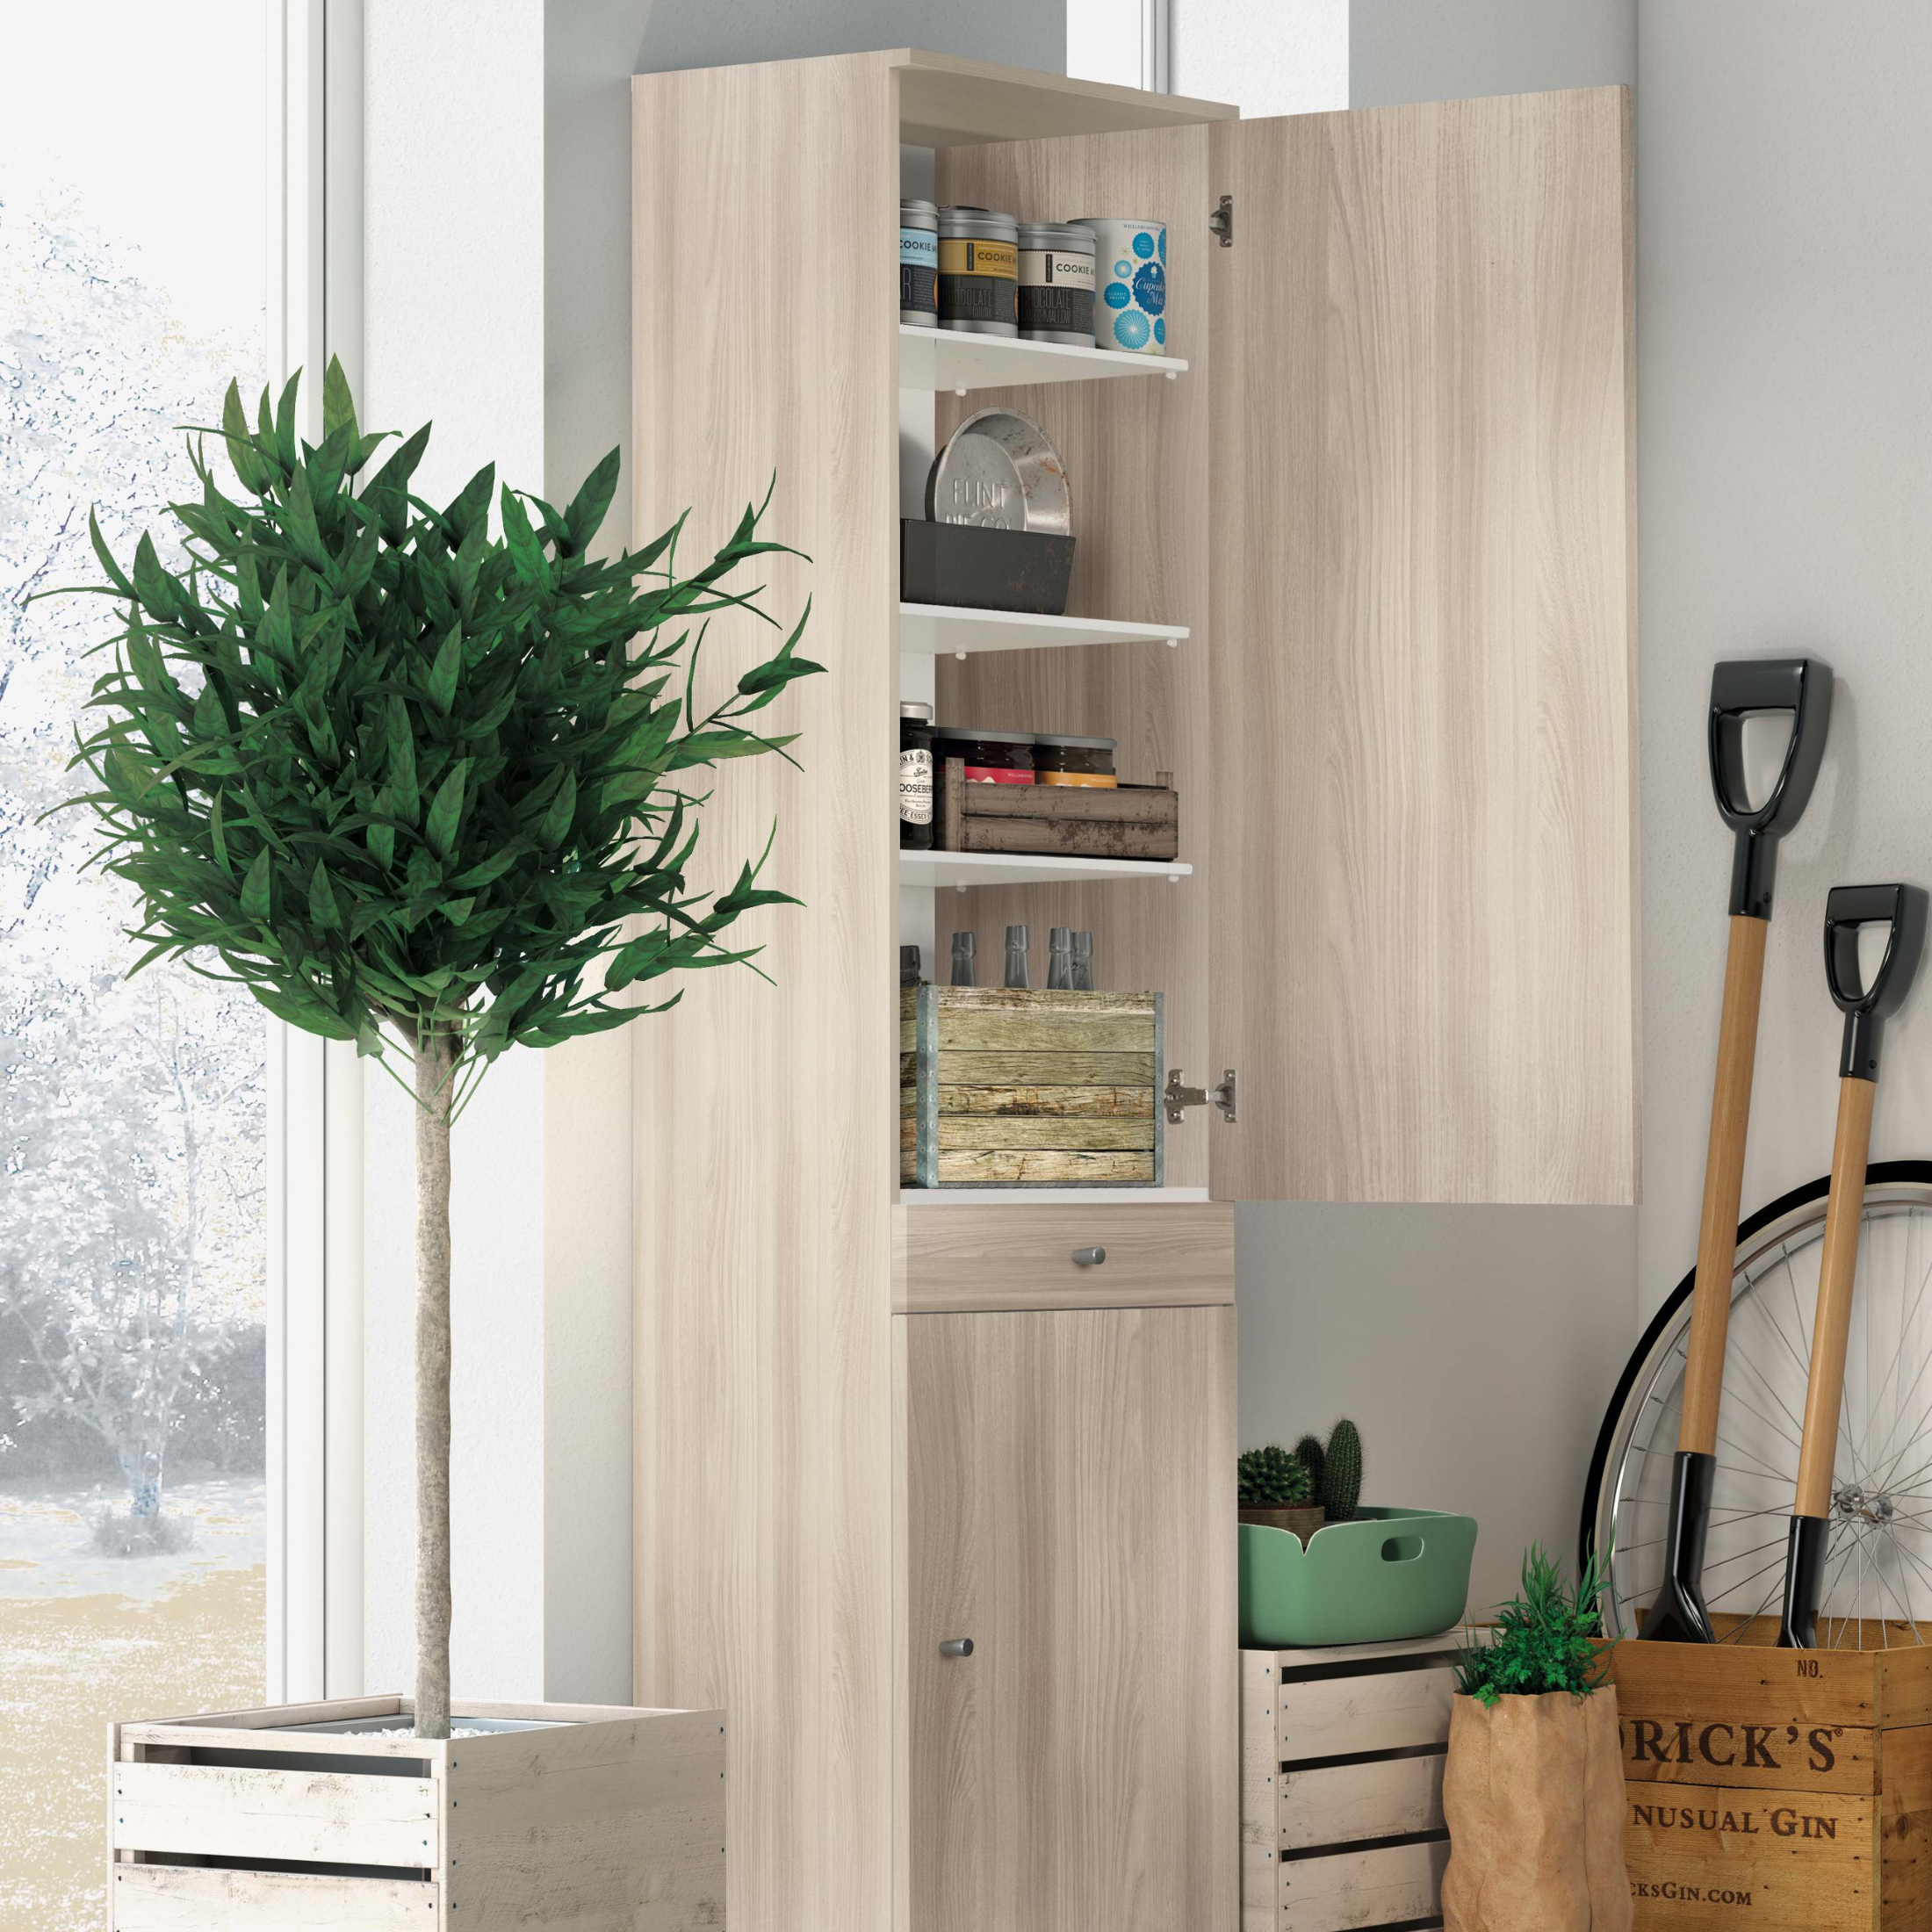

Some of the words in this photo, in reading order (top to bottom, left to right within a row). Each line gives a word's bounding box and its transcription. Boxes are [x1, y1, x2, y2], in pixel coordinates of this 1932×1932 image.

[977, 251, 1012, 263] COOKIE
[1056, 263, 1089, 275] COOKIE
[1021, 287, 1071, 310] CHOCOLATE
[953, 479, 1008, 510] FLINT
[1797, 1659, 1823, 1678] NO.
[1618, 1719, 1836, 1773] RICK'S
[1633, 1805, 1760, 1835] NUSUAL
